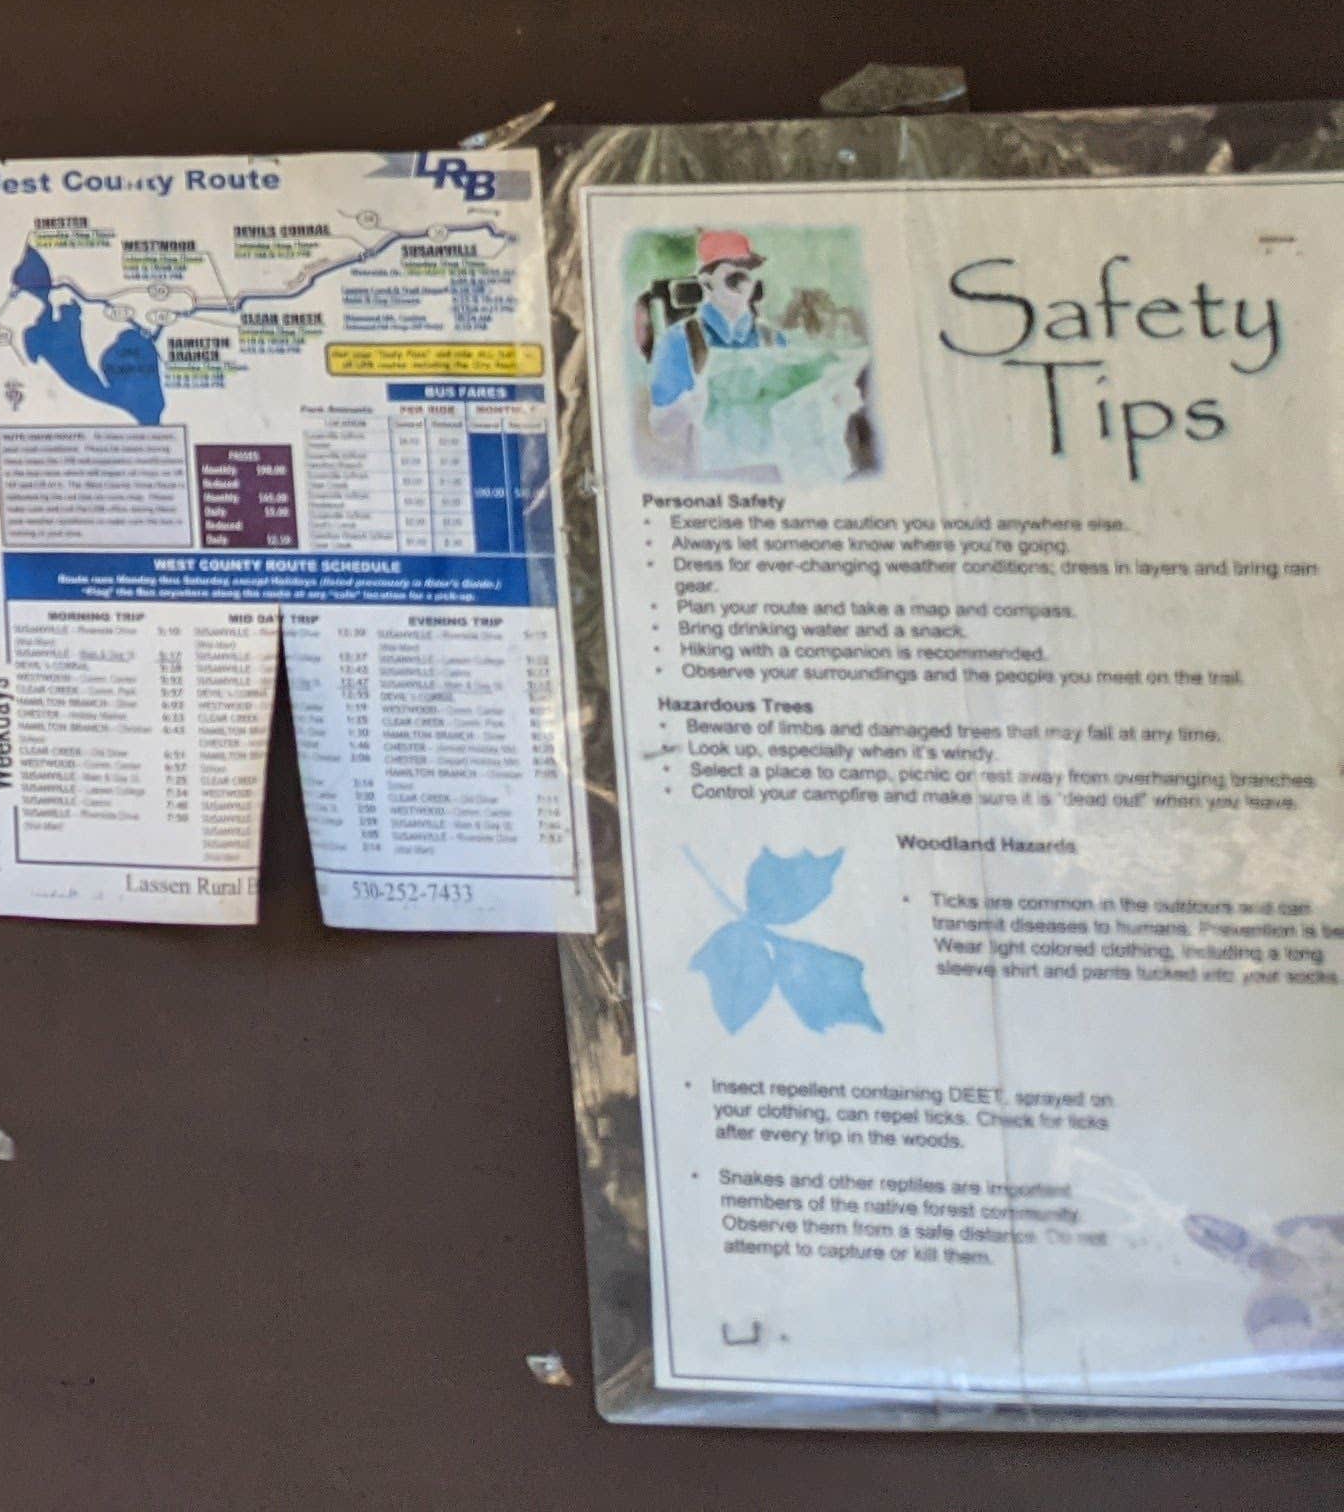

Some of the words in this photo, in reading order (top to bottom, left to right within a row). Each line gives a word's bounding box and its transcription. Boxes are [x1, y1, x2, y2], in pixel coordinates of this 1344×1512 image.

[185, 169, 280, 191] Route
[415, 153, 496, 201] LRB
[940, 255, 1280, 374] Safety
[1002, 360, 1226, 481] Tips
[641, 492, 722, 508] Personal
[727, 493, 785, 512] Safety
[669, 513, 744, 530] Exercise
[747, 514, 776, 530] the
[780, 517, 829, 530] same
[832, 515, 897, 530] caution
[902, 517, 936, 533] you
[671, 535, 733, 557] Always
[737, 535, 758, 551] let
[763, 538, 844, 552] someone
[847, 536, 895, 552] know
[899, 536, 956, 553] where
[153, 558, 195, 571] WEST
[198, 558, 262, 571] COUNTY
[265, 558, 317, 572] ROUTE
[321, 559, 400, 573] SCHEDULE
[676, 595, 715, 615] Plan
[719, 601, 758, 618] your
[762, 601, 808, 615] route
[812, 600, 846, 616] and
[850, 600, 889, 616] take
[893, 603, 905, 616] a
[909, 603, 951, 619] map
[954, 602, 988, 618] and
[678, 619, 724, 639] Bring
[727, 621, 797, 640] drinking
[801, 622, 850, 637] water
[854, 622, 888, 637] and
[893, 624, 906, 638] a
[909, 623, 966, 639] snack.
[679, 641, 734, 663] Hiking
[738, 642, 774, 657] with
[778, 645, 790, 658] a
[794, 645, 892, 661] companion
[896, 646, 912, 660] is
[657, 696, 756, 712] Hazardous
[761, 697, 813, 714] Trees
[687, 739, 730, 762] Look
[734, 743, 762, 759] up,
[767, 743, 854, 762] especially
[858, 744, 907, 759] when
[941, 745, 994, 764] windy.
[895, 834, 996, 852] Woodland
[1000, 836, 1077, 854] Hazards
[125, 872, 191, 894] Lassen
[197, 876, 242, 896] Rural
[715, 1122, 755, 1140] after
[759, 1127, 809, 1146] every
[813, 1127, 842, 1146] trip
[847, 1129, 863, 1144] in
[867, 1129, 896, 1146] the
[901, 1131, 964, 1149] woods.
